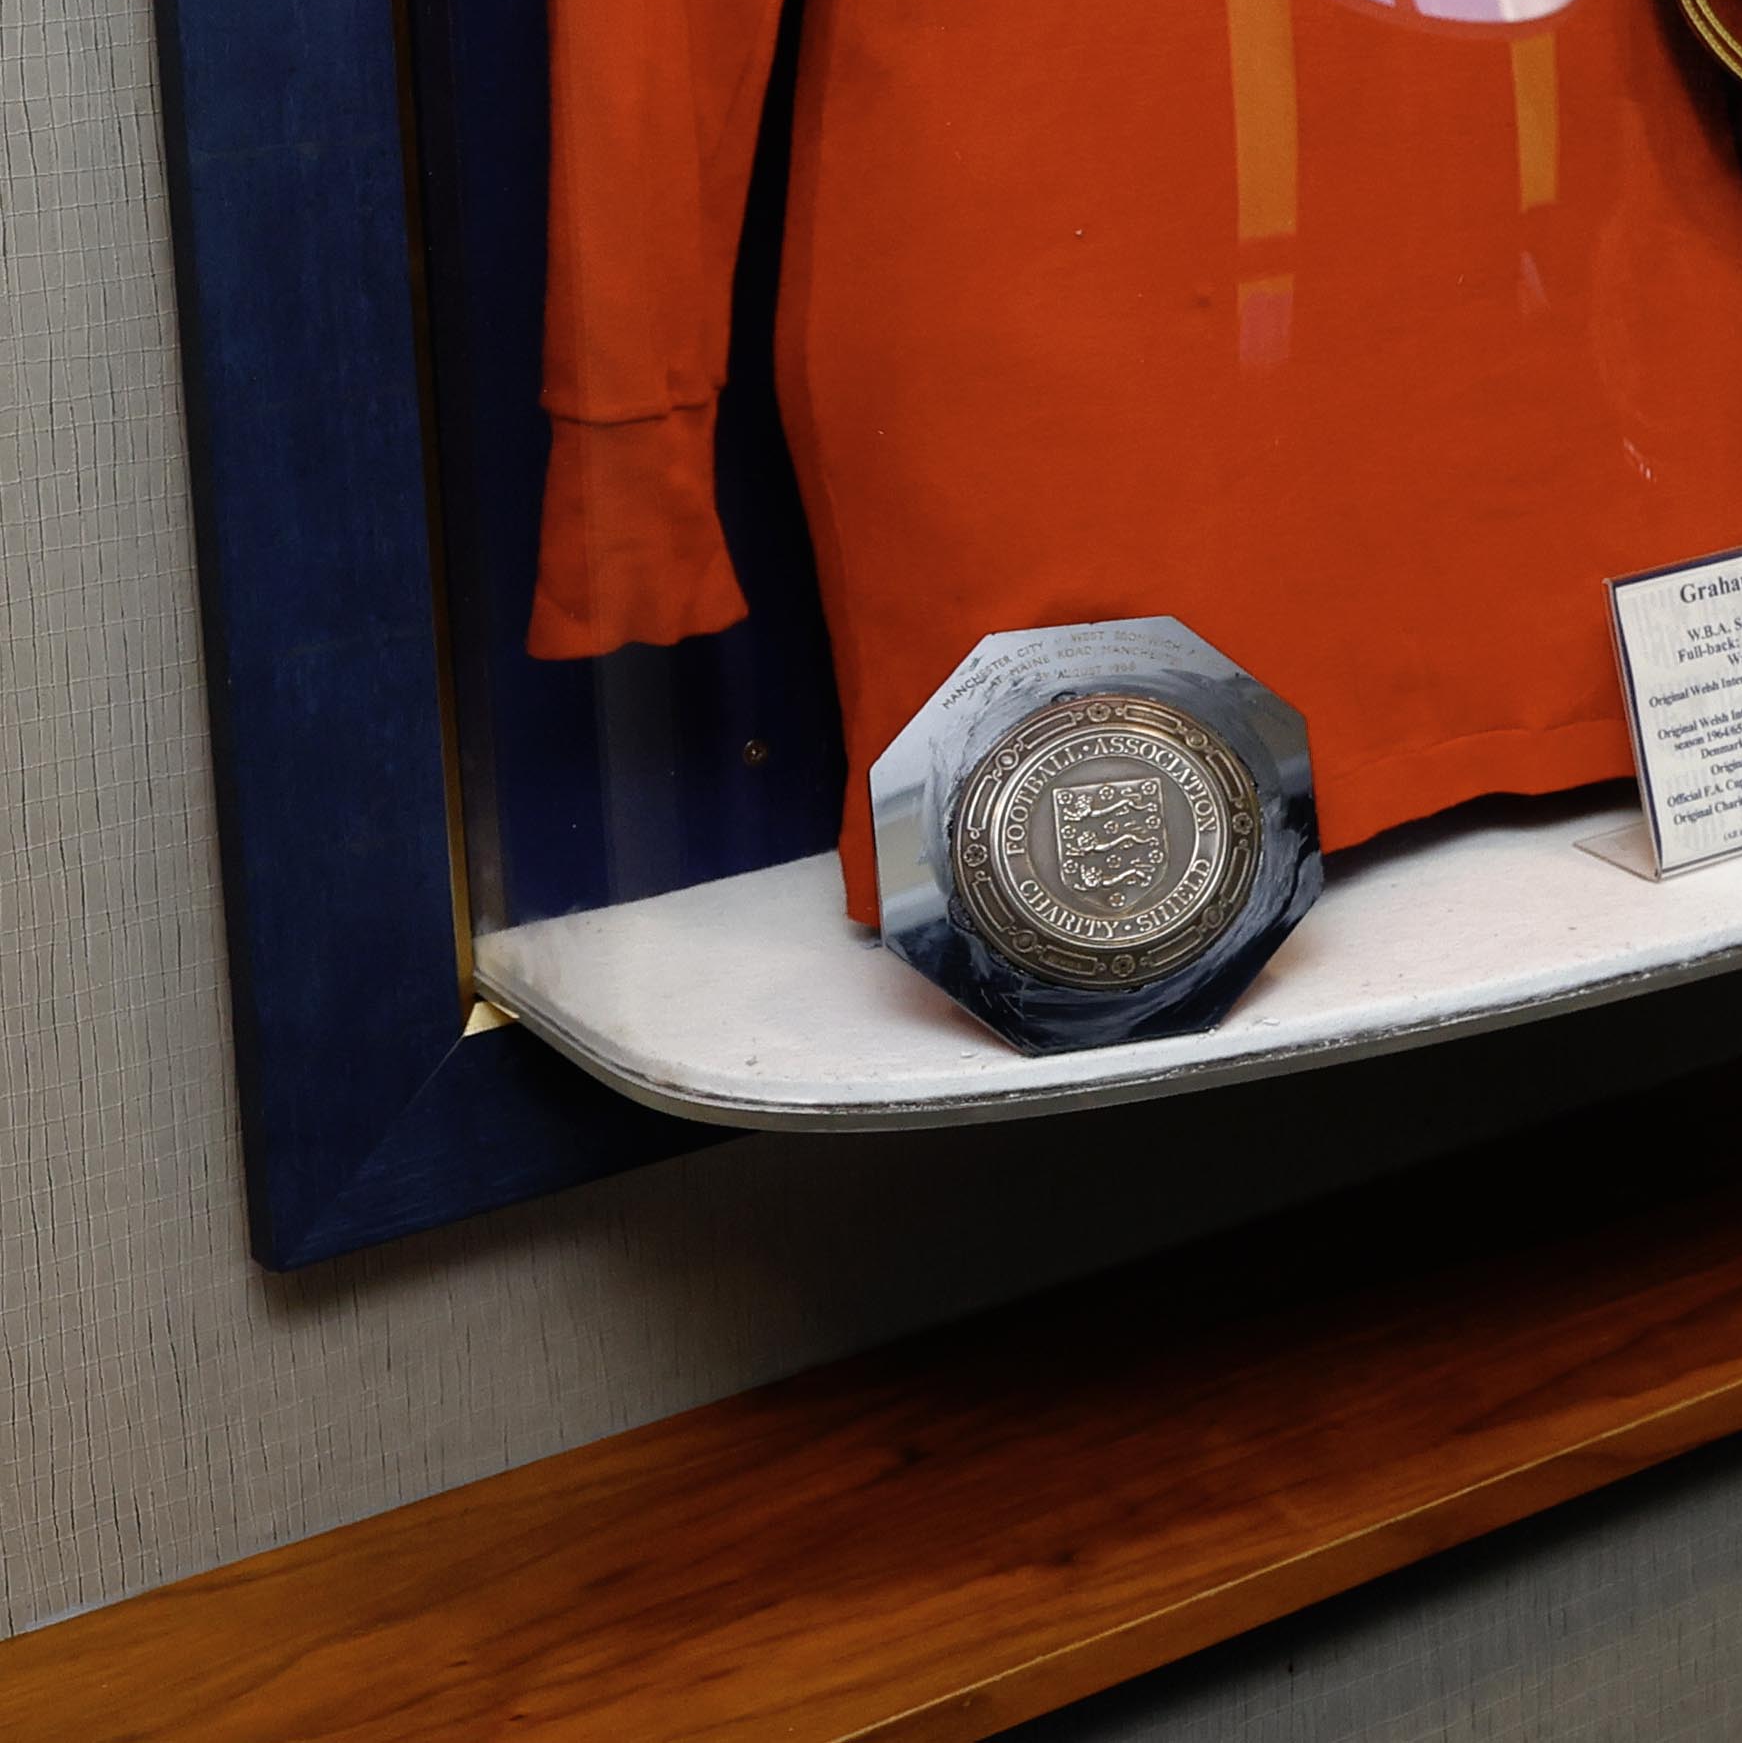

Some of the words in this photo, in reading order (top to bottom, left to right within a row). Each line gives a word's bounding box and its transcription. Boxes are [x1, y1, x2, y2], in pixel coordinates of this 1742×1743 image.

[1687, 622, 1731, 640] W.B.A.
[1017, 641, 1044, 658] CITY
[1677, 637, 1739, 662] Full-back:
[1648, 688, 1688, 707] Original
[1689, 680, 1719, 695] Welsh
[1657, 720, 1697, 739] Original
[1698, 713, 1728, 727] Welsh
[1674, 737, 1704, 749] season
[1006, 747, 1082, 856] FOOTBALL
[1094, 736, 1217, 833] ASSOCIATION
[1667, 788, 1701, 807] Official
[1703, 783, 1723, 797] F.A.
[1673, 804, 1712, 824] Original
[1019, 879, 1119, 939] CHARITY
[1136, 858, 1211, 933] SHIELD
